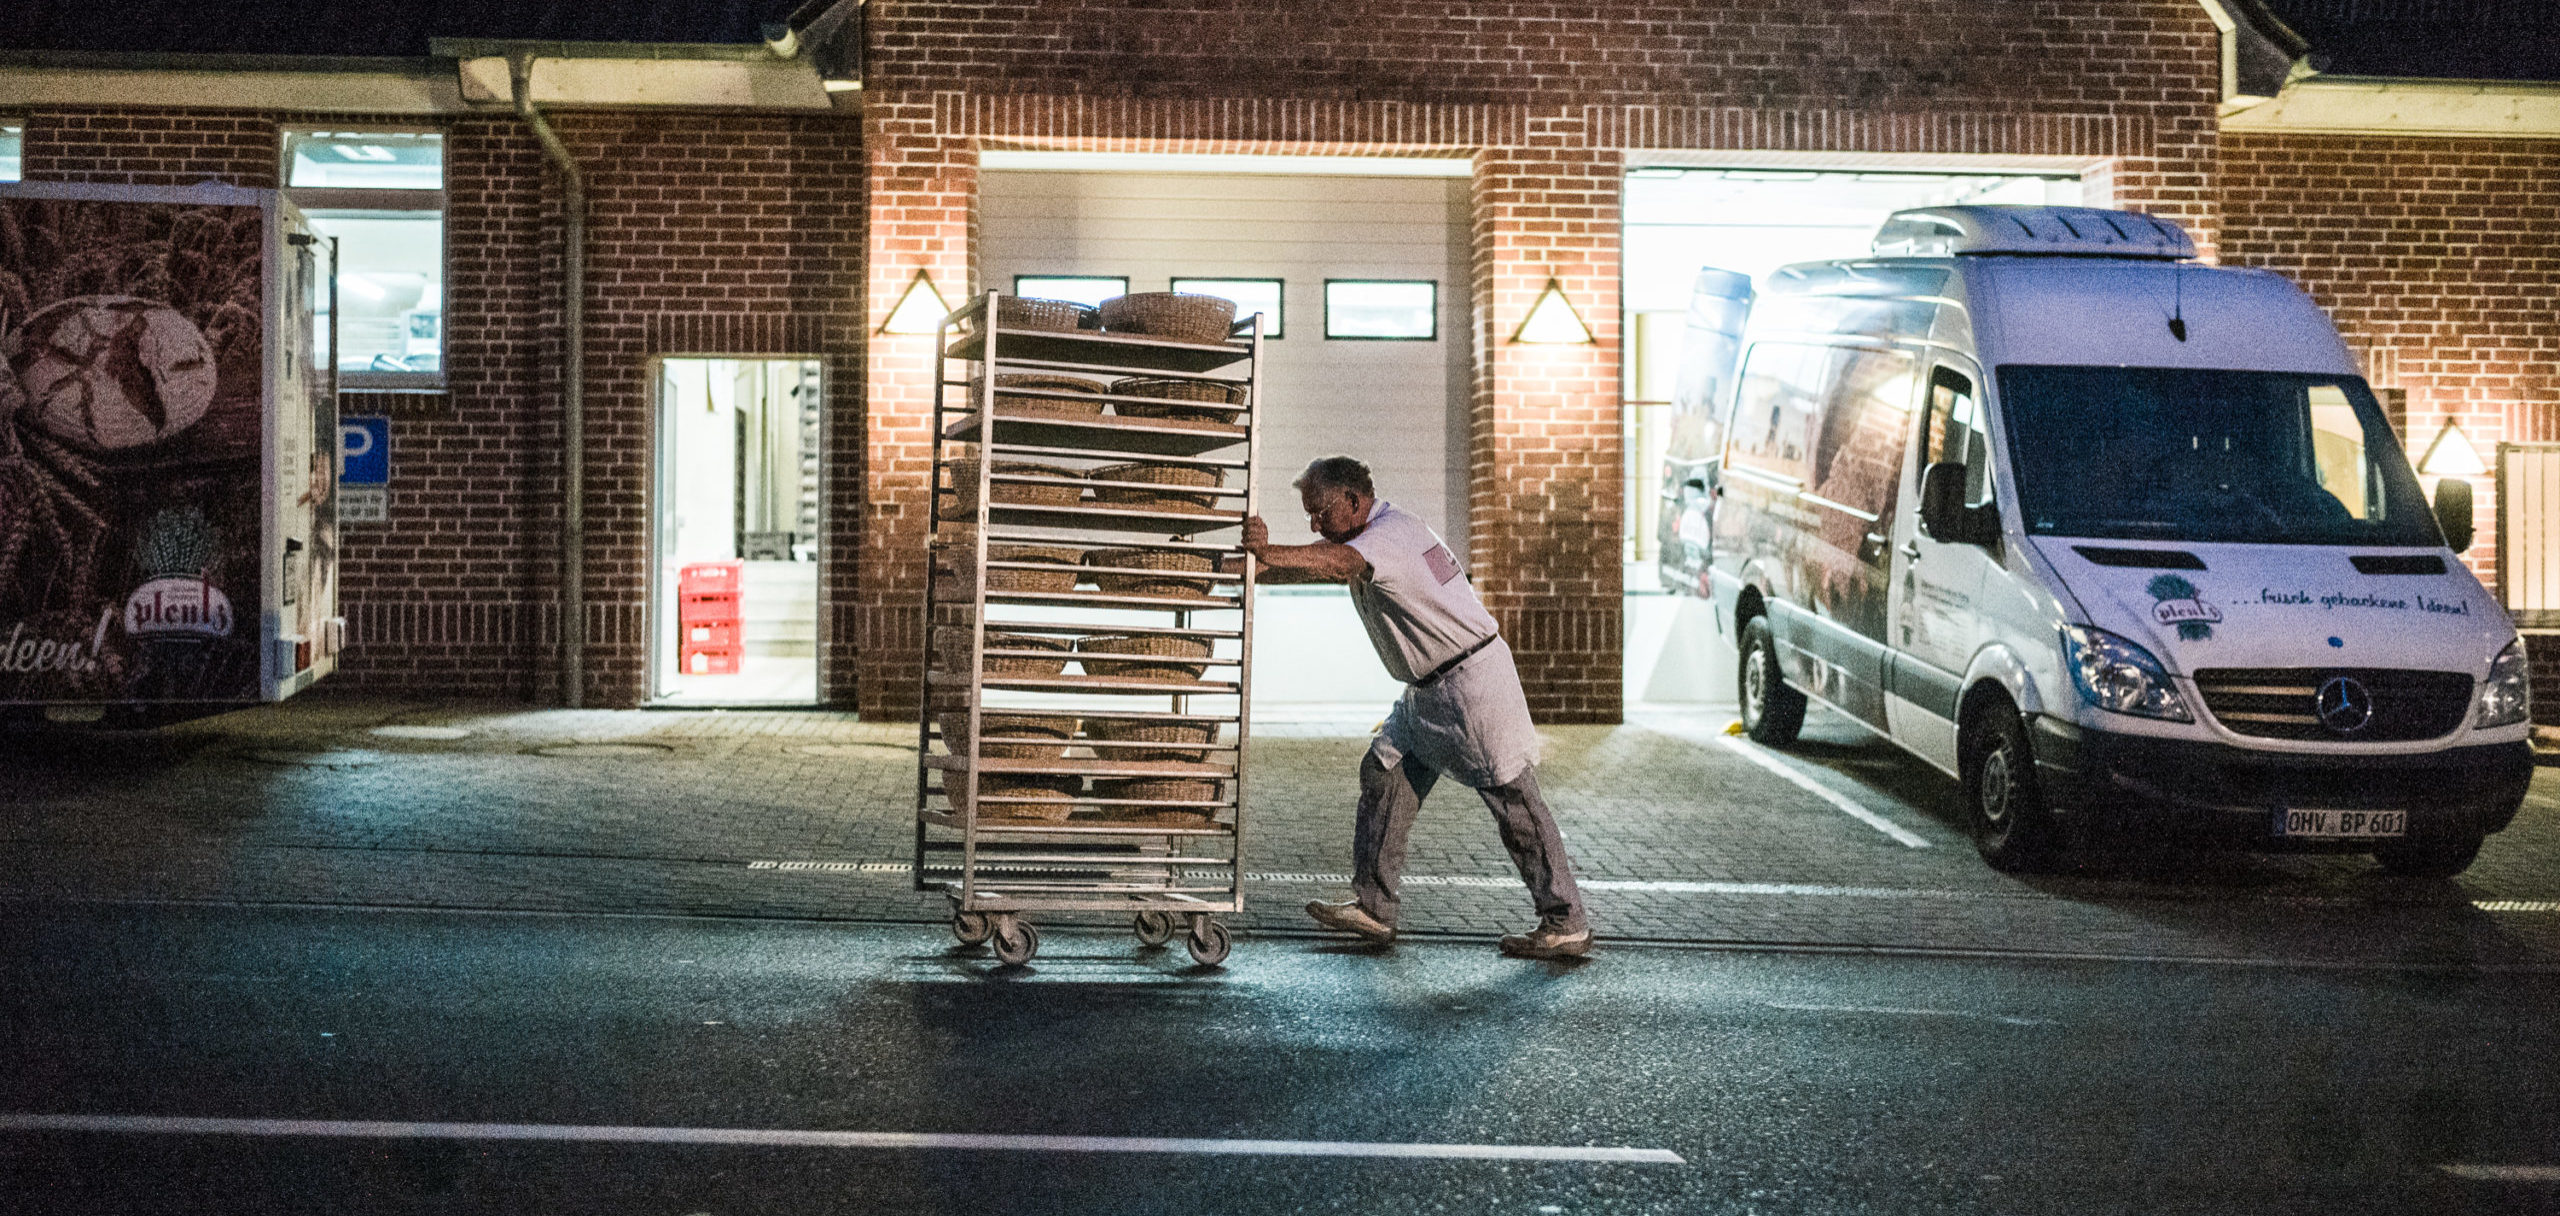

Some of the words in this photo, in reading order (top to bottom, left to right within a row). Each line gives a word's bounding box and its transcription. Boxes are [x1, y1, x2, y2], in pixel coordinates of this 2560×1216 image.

[338, 425, 373, 476] P
[2288, 811, 2327, 833] OHV
[2340, 812, 2366, 833] BP
[2370, 812, 2404, 833] 601
